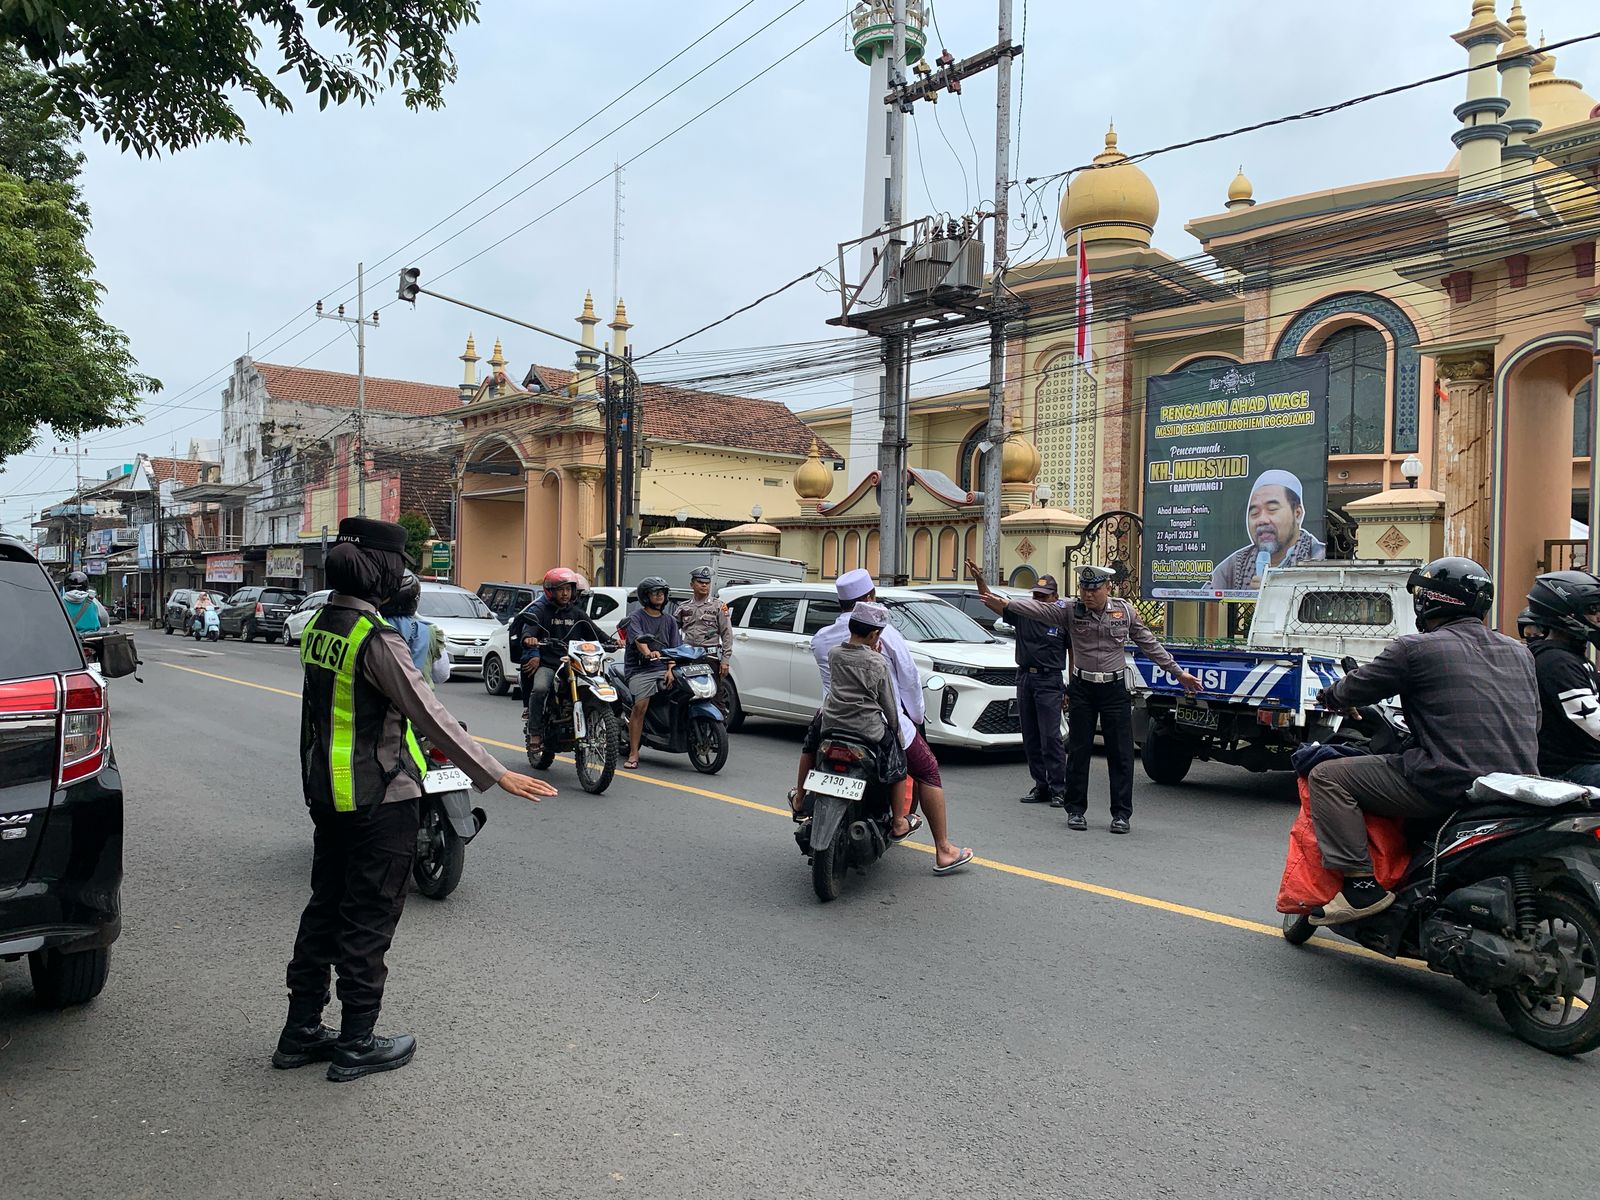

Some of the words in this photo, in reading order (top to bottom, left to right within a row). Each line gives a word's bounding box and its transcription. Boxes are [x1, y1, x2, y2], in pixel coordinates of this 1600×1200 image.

[1161, 403, 1227, 421] PENGAJIAN
[1230, 397, 1266, 414] AHAD
[1269, 392, 1308, 410] WAGE
[1156, 426, 1180, 437] MASJID
[1182, 423, 1204, 434] BESAR
[1206, 416, 1262, 432] BAITURROHIEM
[1264, 412, 1314, 426] ROGOJAMPI
[1169, 443, 1220, 457] Penceramah
[1151, 462, 1172, 480] KH.
[1174, 457, 1247, 479] MURSYIDI
[1173, 482, 1219, 493] BANYUWANGI
[1157, 506, 1171, 514] Ahad
[1173, 506, 1191, 514] Malam
[1192, 505, 1210, 514] Senin,
[1170, 518, 1192, 528] Tanggal
[1157, 532, 1163, 540] 27
[1165, 531, 1177, 541] April
[1179, 531, 1192, 539] 2025
[1157, 543, 1163, 551] 28
[1165, 543, 1183, 553] Syawal
[1185, 543, 1198, 551] 1446
[1201, 543, 1206, 551] H
[1153, 560, 1173, 573] Pukul
[1196, 560, 1212, 573] WIB
[1151, 665, 1227, 690] POISI
[436, 770, 460, 781] 3549
[809, 772, 815, 780] P
[822, 775, 845, 786] 2130
